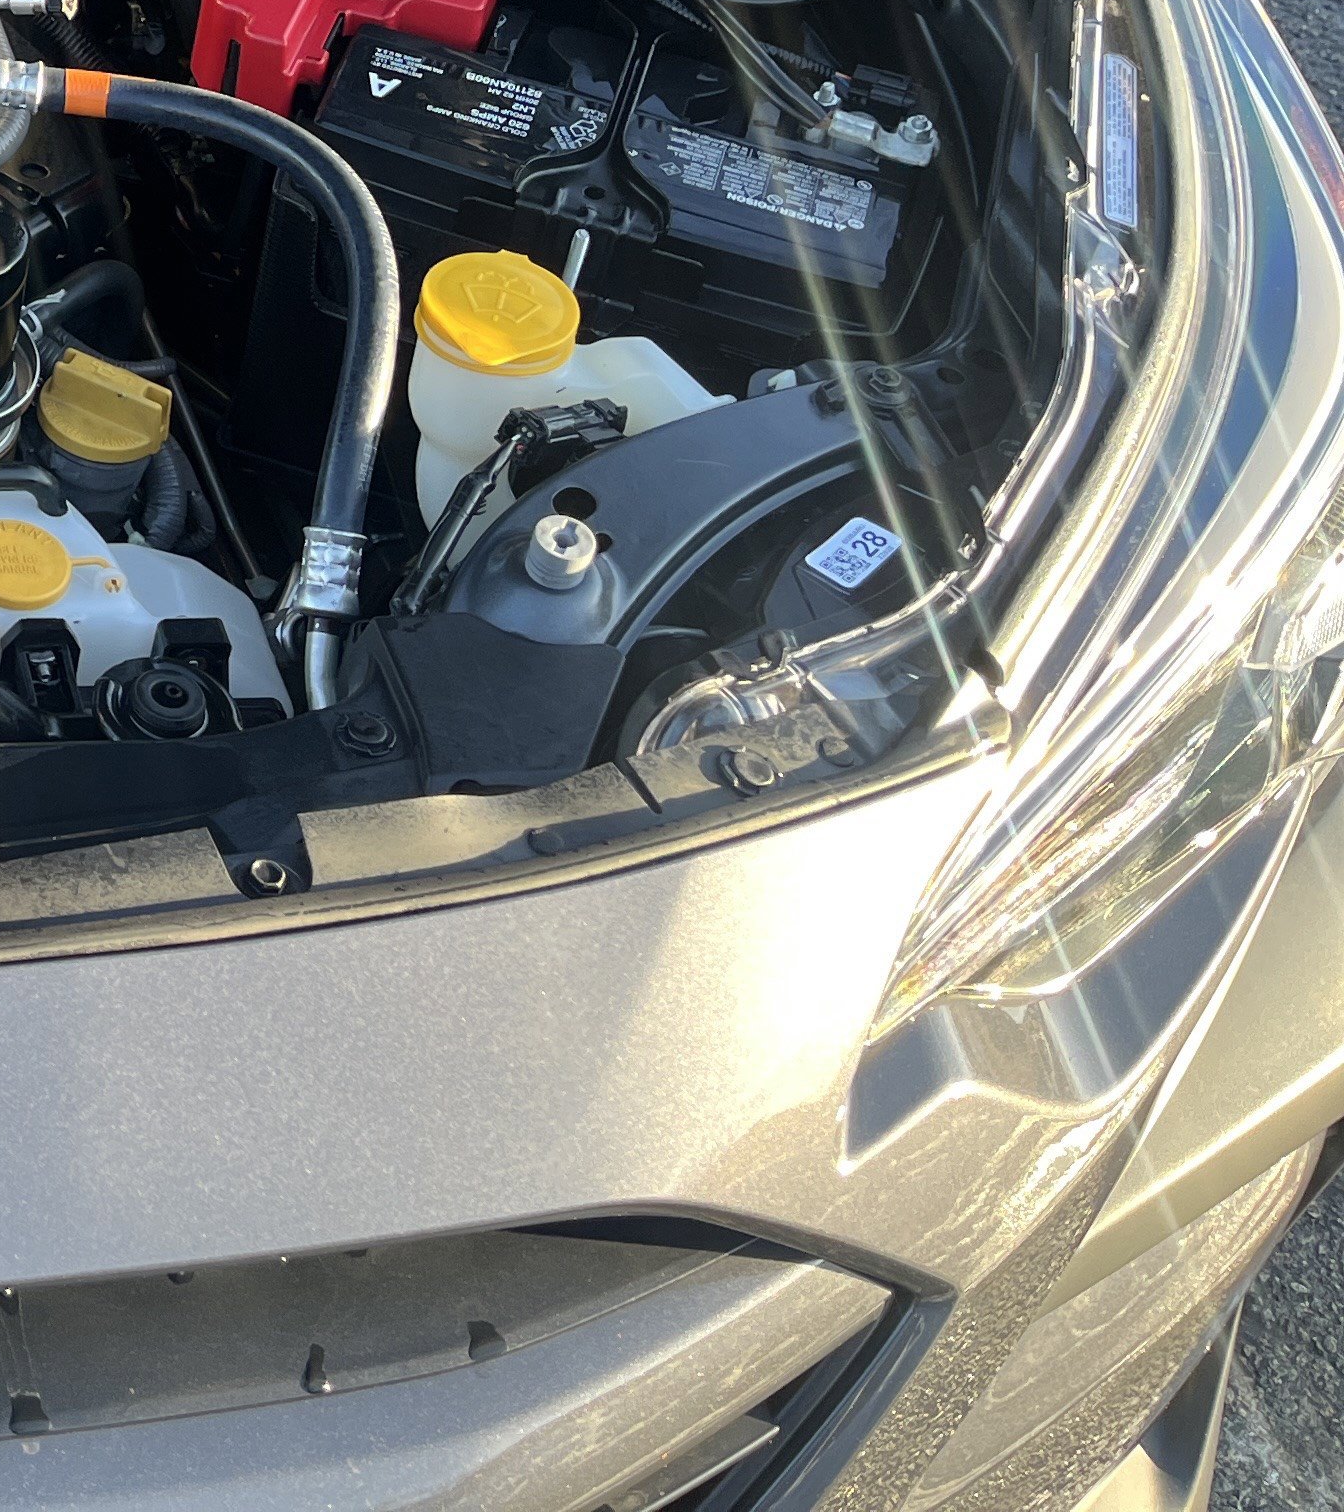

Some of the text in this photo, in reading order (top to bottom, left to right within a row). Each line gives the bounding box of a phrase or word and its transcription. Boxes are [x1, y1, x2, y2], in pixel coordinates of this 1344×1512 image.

[486, 86, 502, 96] AH
[469, 107, 507, 125] AMPS
[478, 101, 534, 122] GROUP SIZE
[510, 100, 536, 115] LN2
[425, 103, 528, 138] COLD CRANKING AMPS
[725, 191, 833, 229] DANGER/POISON
[851, 530, 886, 557] 28
